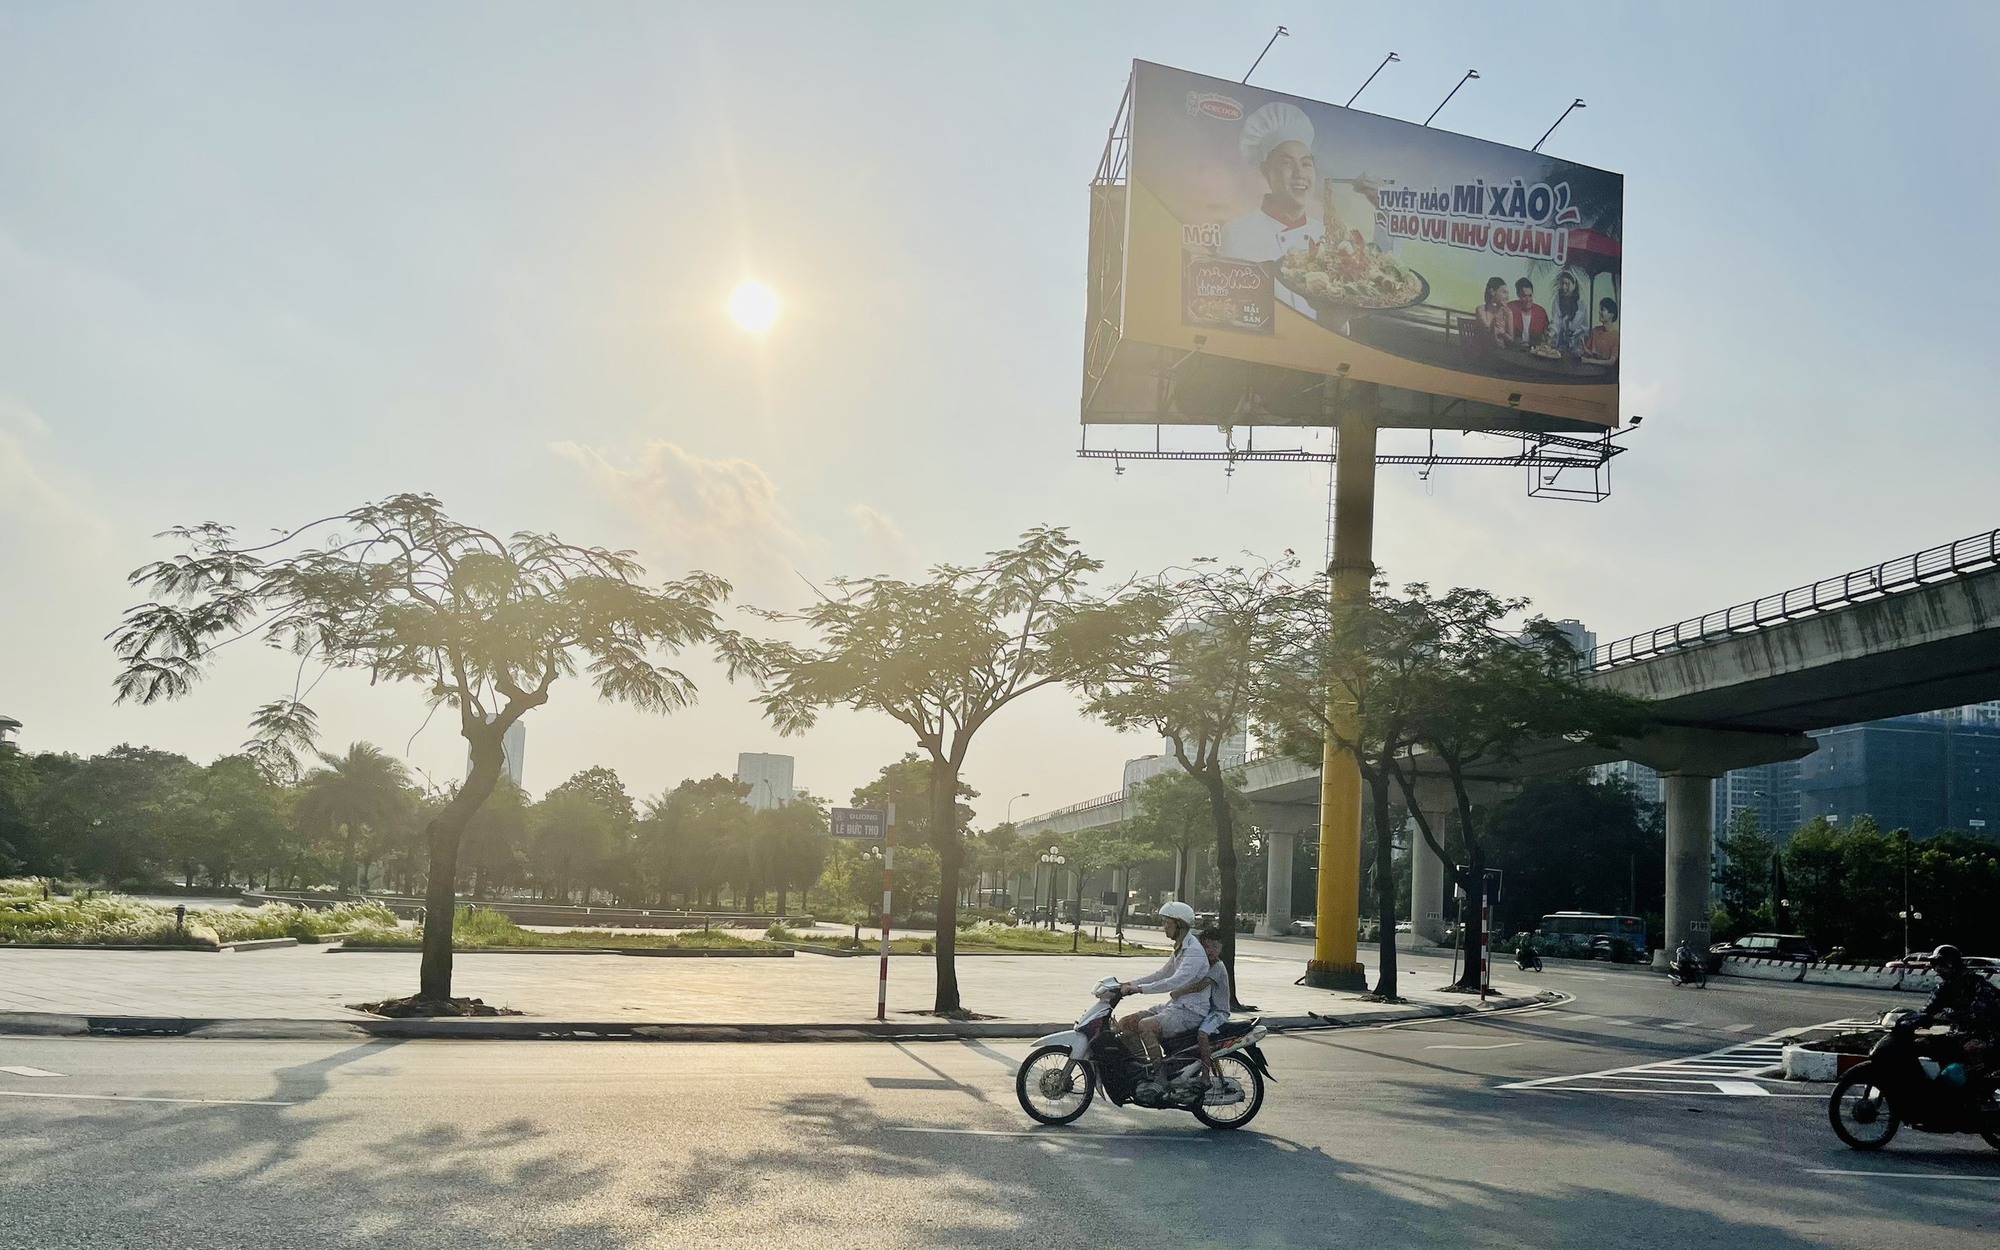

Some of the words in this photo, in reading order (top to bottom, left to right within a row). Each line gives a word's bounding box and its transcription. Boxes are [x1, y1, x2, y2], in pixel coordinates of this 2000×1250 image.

[1379, 187, 1417, 212] TUYỆT
[1420, 187, 1450, 213] HẢO
[1453, 179, 1484, 215] MÌ
[1488, 180, 1551, 221] XÀO
[1183, 223, 1221, 246] Mới
[1422, 218, 1447, 240] VUI
[1451, 222, 1491, 248] NHƯ
[1493, 226, 1553, 257] QUÁN
[1243, 303, 1260, 314] HẢI
[1243, 313, 1261, 324] SẢN
[835, 822, 845, 834] LÊ
[846, 821, 863, 835] ĐỨC
[864, 825, 879, 838] THỌ
